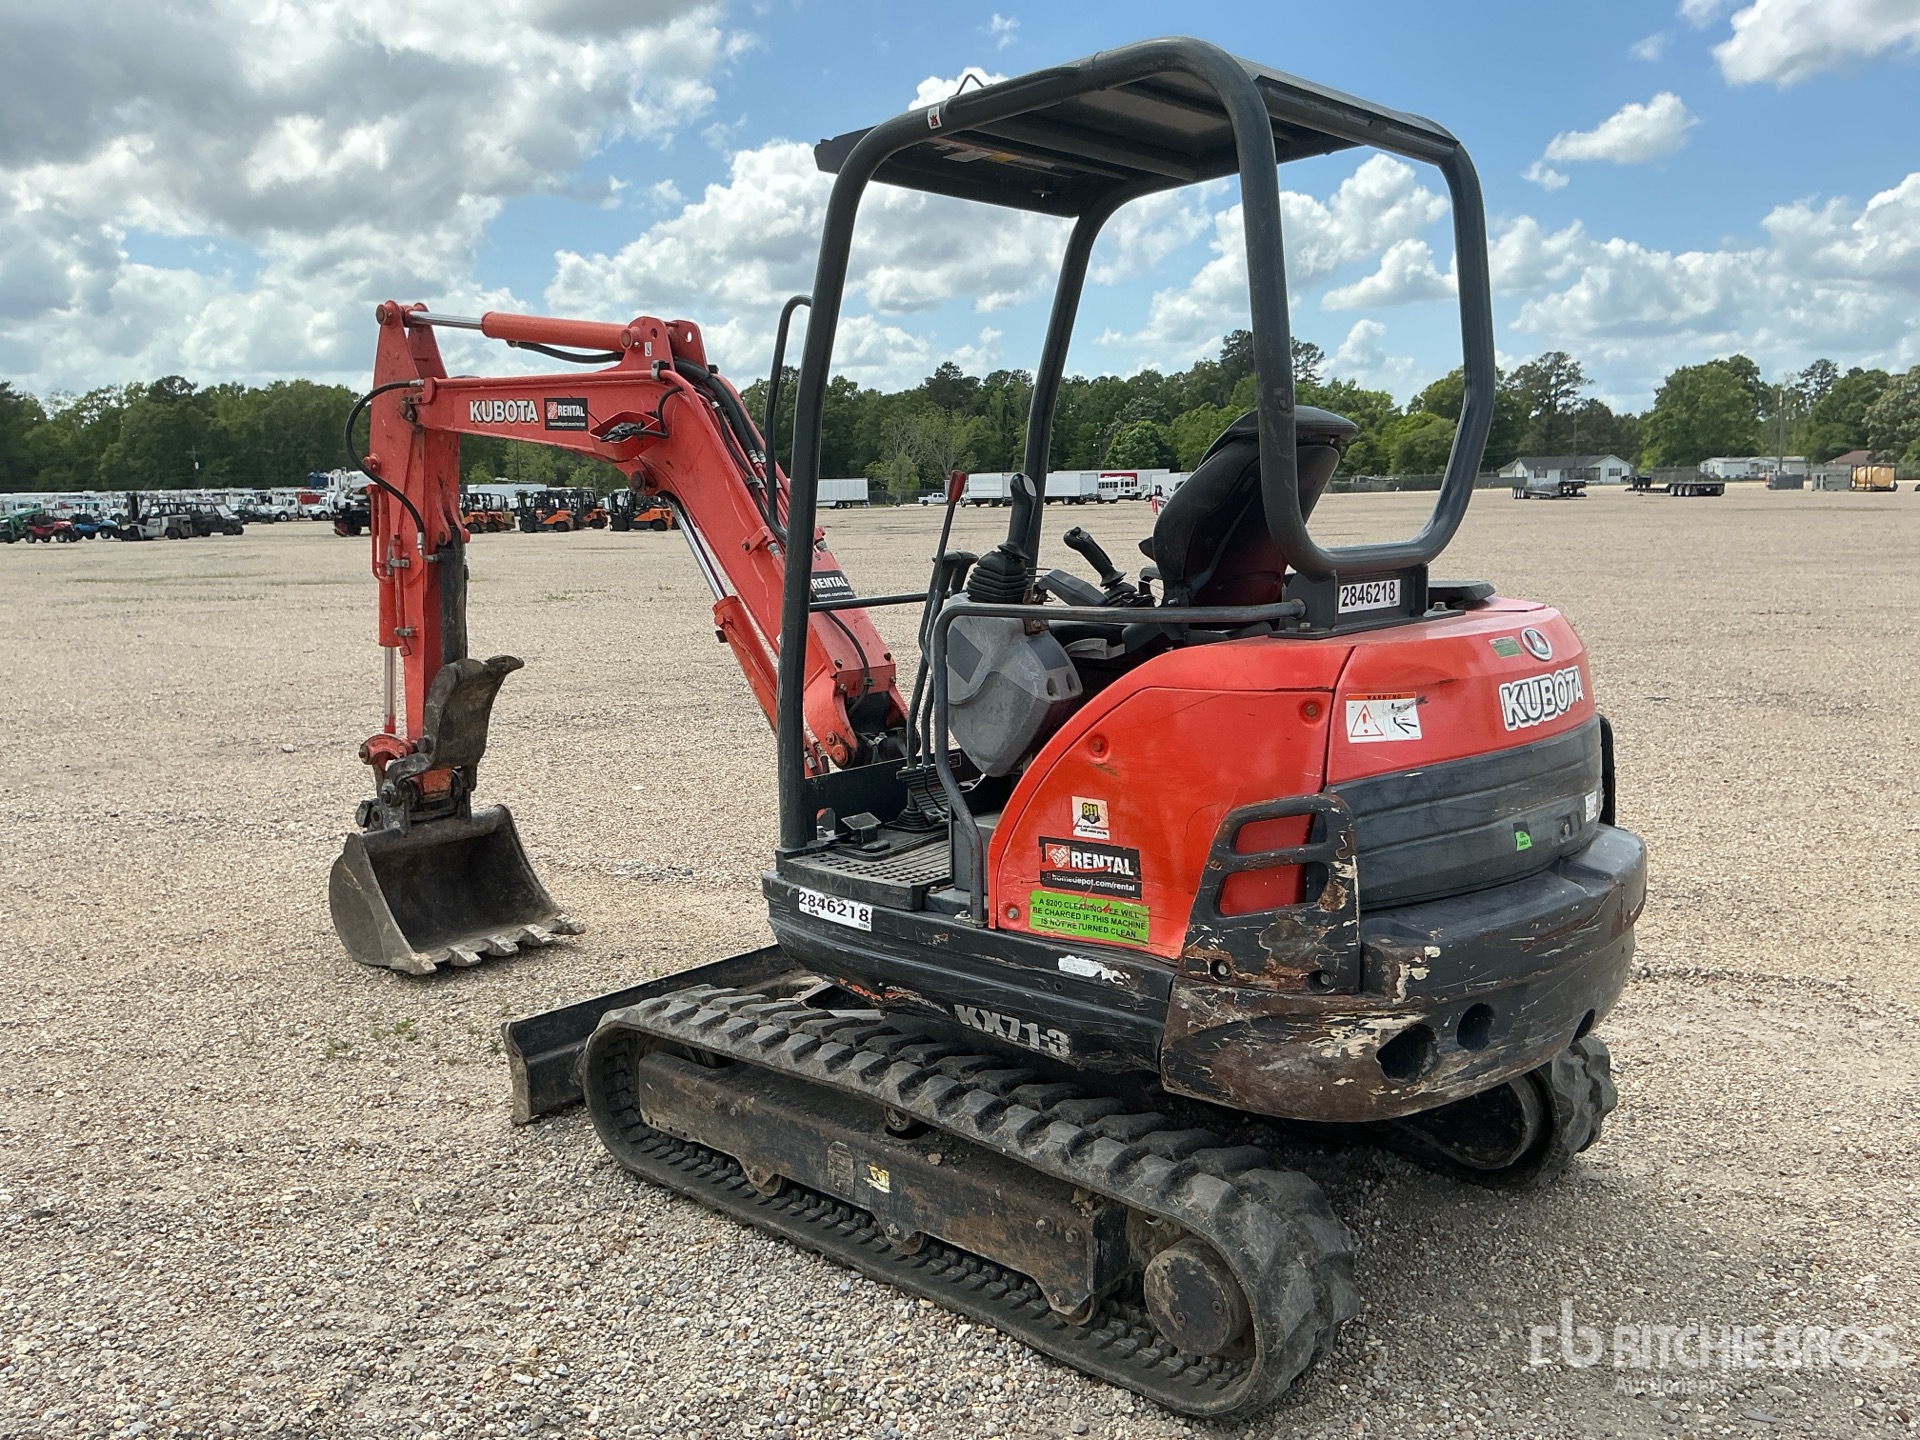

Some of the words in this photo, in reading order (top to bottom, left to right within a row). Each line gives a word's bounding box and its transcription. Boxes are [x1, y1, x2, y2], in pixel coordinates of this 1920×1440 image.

[469, 399, 540, 423] KUBOTA
[557, 404, 586, 417] RENTAL
[811, 576, 849, 590] RENTAL
[1341, 581, 1396, 608] 2846218
[1500, 667, 1584, 728] KUBOTA
[1082, 803, 1098, 817] 811
[1070, 851, 1135, 876] RENTAL
[1051, 873, 1136, 892] homedepot.com/rental
[799, 891, 869, 922] 2846218
[1032, 906, 1043, 915] BE
[1044, 909, 1081, 920] CHARGED
[1092, 915, 1110, 924] THIS
[1110, 917, 1147, 931] MACHINE
[1064, 901, 1103, 913] CLEANING
[1103, 904, 1119, 915] EE
[1121, 908, 1140, 919] WILL
[1041, 917, 1048, 925] IS
[1049, 919, 1066, 927] NOT
[1067, 921, 1109, 934] RETURNED
[1110, 927, 1137, 939] CLEAN
[953, 1004, 1072, 1057] KX71-3
